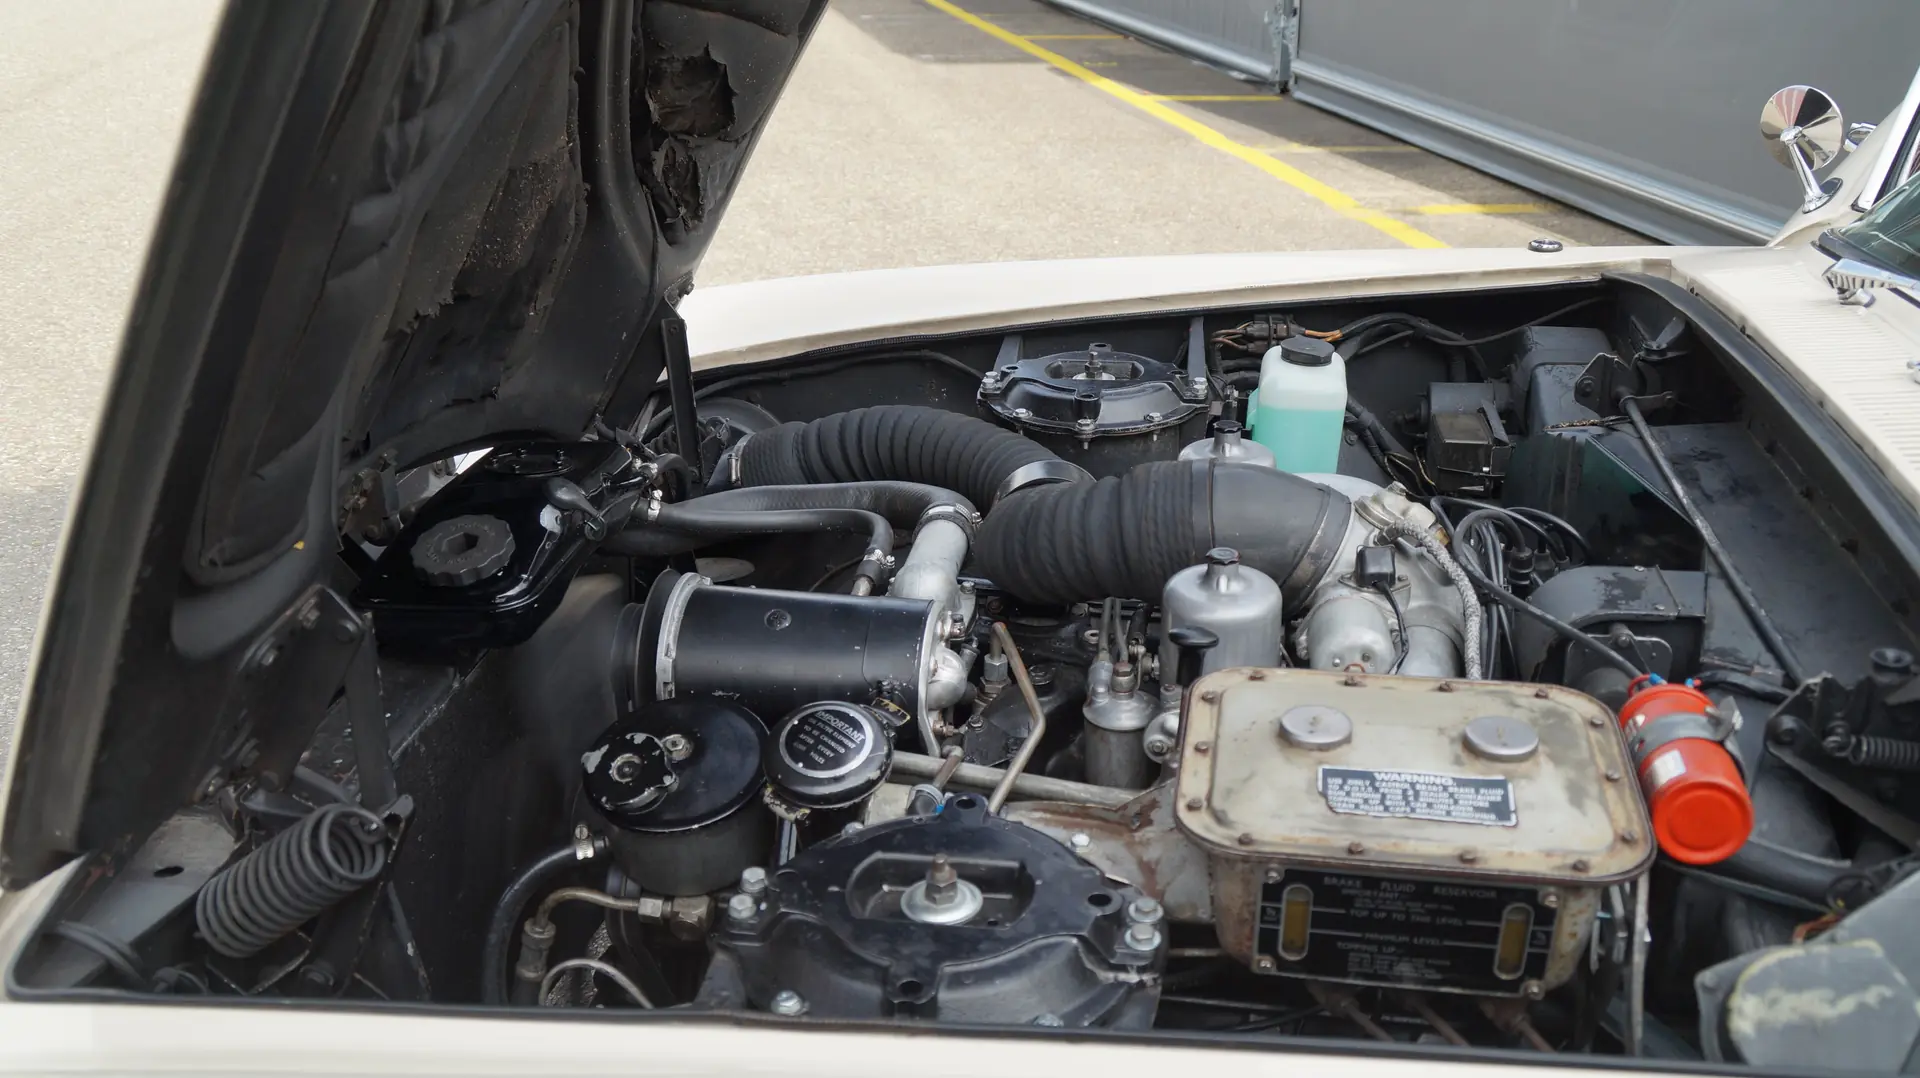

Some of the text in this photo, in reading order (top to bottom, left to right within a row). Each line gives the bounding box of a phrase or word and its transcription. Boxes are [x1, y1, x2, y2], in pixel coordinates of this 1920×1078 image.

[814, 710, 866, 742] IMPORTANT
[816, 722, 834, 734] FILTER
[833, 731, 857, 749] ELEMENT
[816, 744, 836, 758] EVERY
[819, 734, 846, 754] CHANGED
[809, 751, 826, 764] MILES
[1323, 876, 1498, 898] BRAKE FLUID RESERVOIR
[1350, 908, 1370, 918] TOP
[1373, 911, 1387, 919] UP
[1392, 912, 1406, 921] TO
[1436, 916, 1463, 926] LEVEL
[1412, 937, 1441, 946] LEVEL
